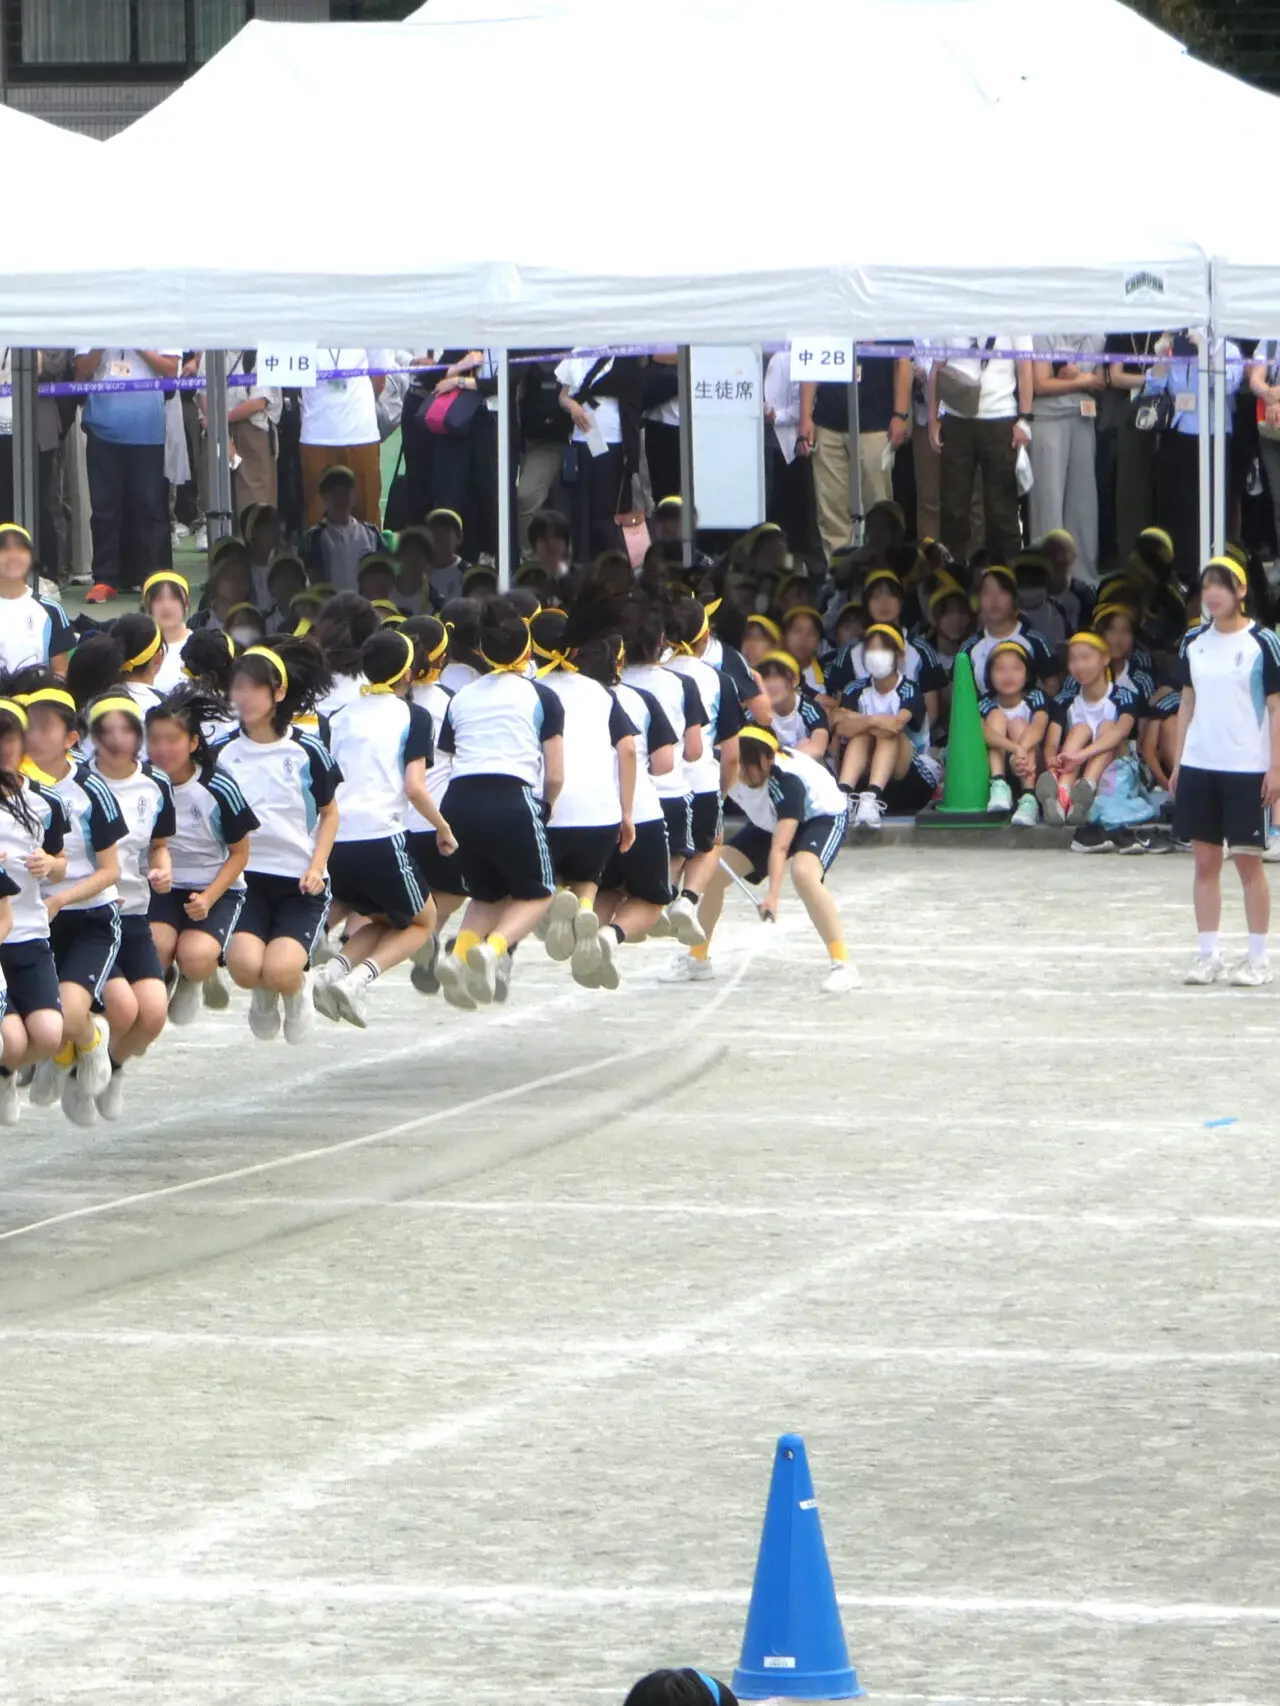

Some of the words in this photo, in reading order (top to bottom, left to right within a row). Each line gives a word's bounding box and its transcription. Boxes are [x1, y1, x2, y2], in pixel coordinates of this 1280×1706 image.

[265, 355, 279, 372] 中
[289, 356, 310, 371] 1B
[799, 349, 813, 366] 中
[820, 350, 845, 366] 2B
[694, 380, 754, 400] 生徒席
